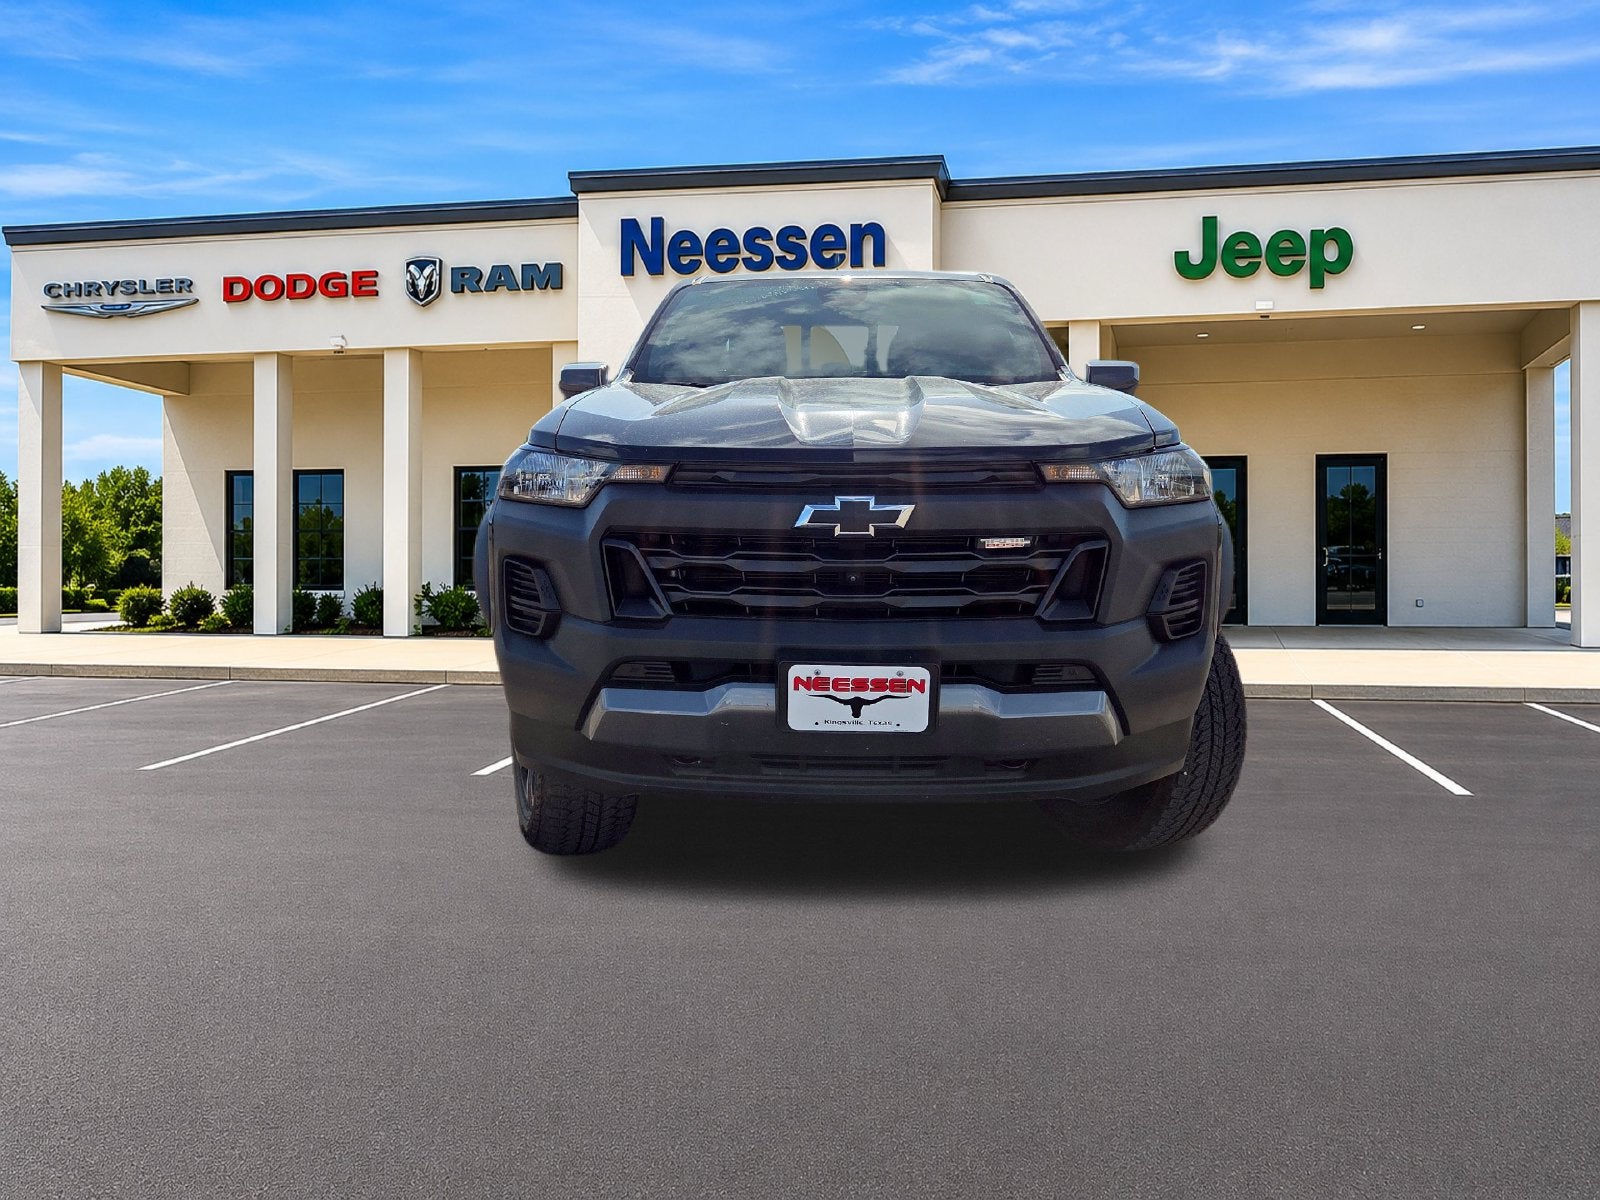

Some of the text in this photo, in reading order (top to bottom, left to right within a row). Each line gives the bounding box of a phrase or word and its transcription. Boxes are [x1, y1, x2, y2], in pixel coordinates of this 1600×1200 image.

[620, 216, 886, 274] Neessen
[1174, 215, 1354, 289] Jeep
[43, 277, 194, 299] CHRYSLER
[222, 270, 379, 302] DODGE
[450, 262, 564, 294] RAM
[793, 676, 926, 693] NEESSEN
